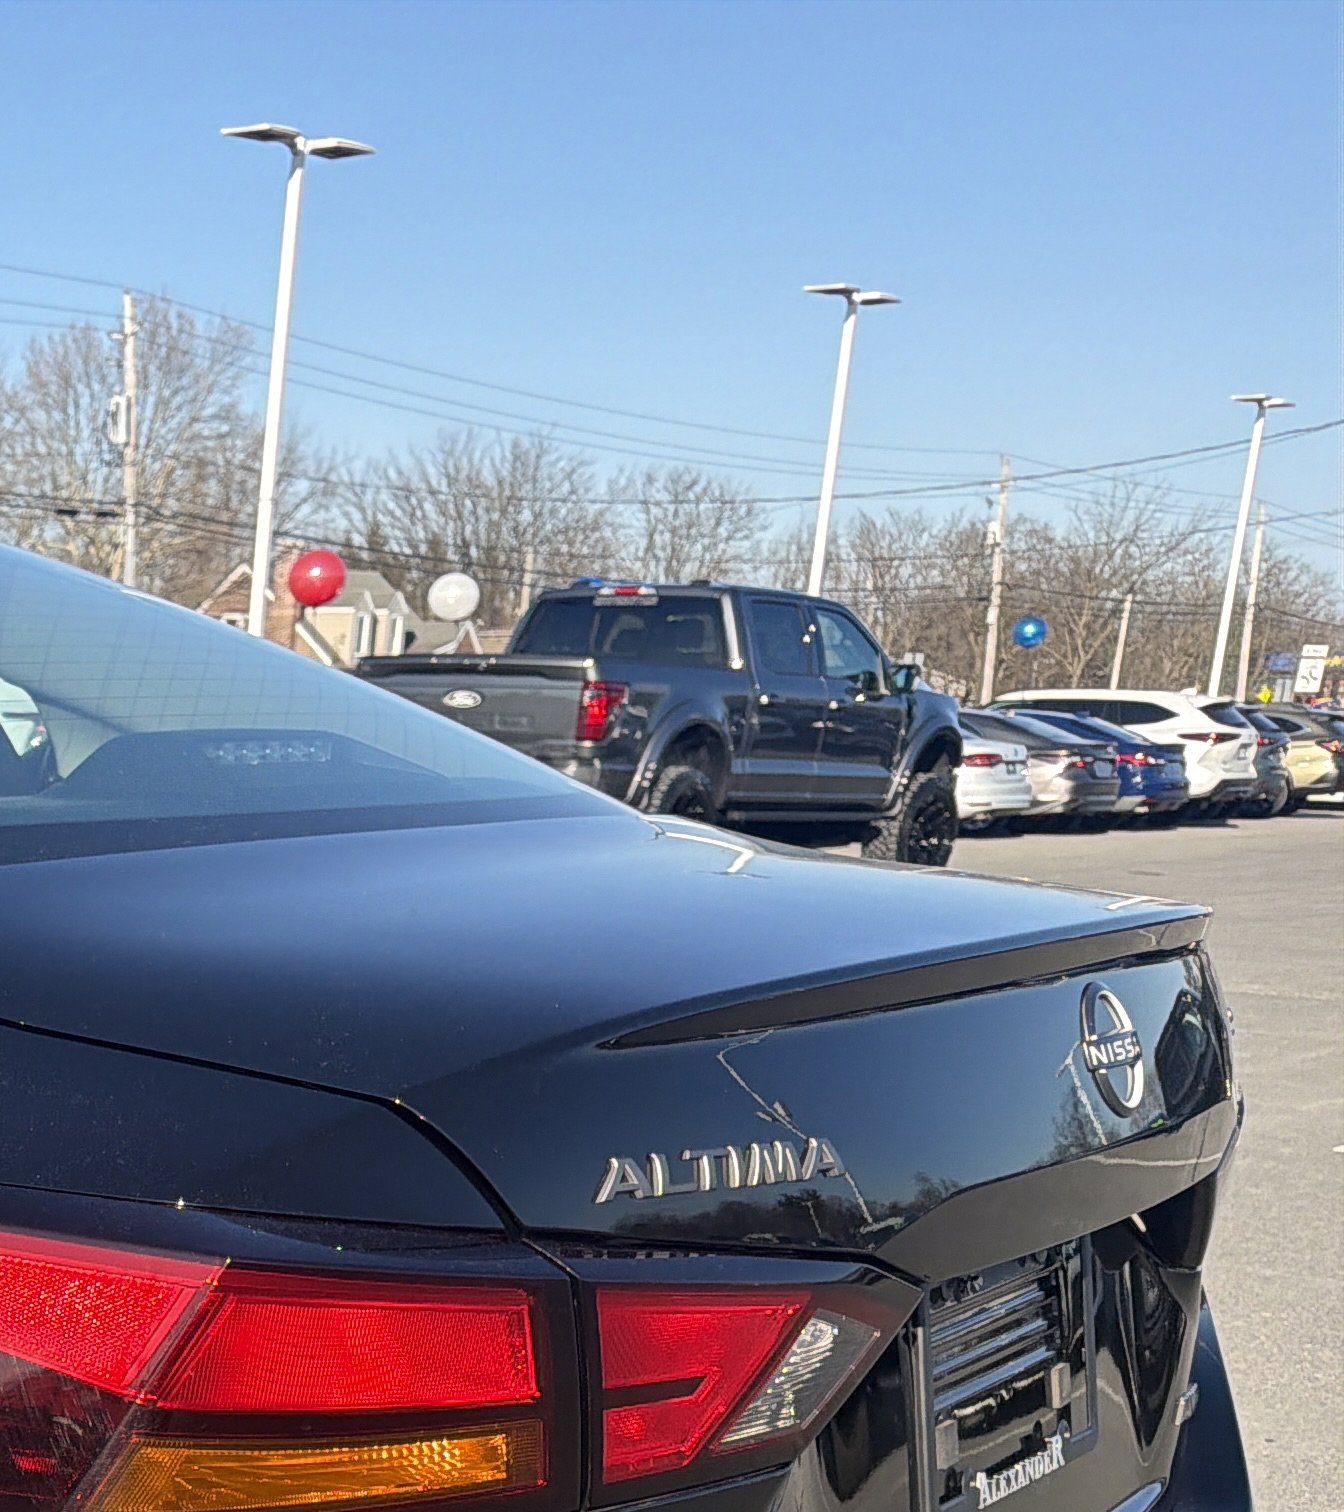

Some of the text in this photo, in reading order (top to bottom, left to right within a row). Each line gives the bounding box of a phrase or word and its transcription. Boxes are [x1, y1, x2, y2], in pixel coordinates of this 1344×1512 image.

[1088, 1035, 1141, 1067] NISS
[593, 1137, 847, 1205] ALTIMA
[976, 1433, 1066, 1510] ALEXANDER
